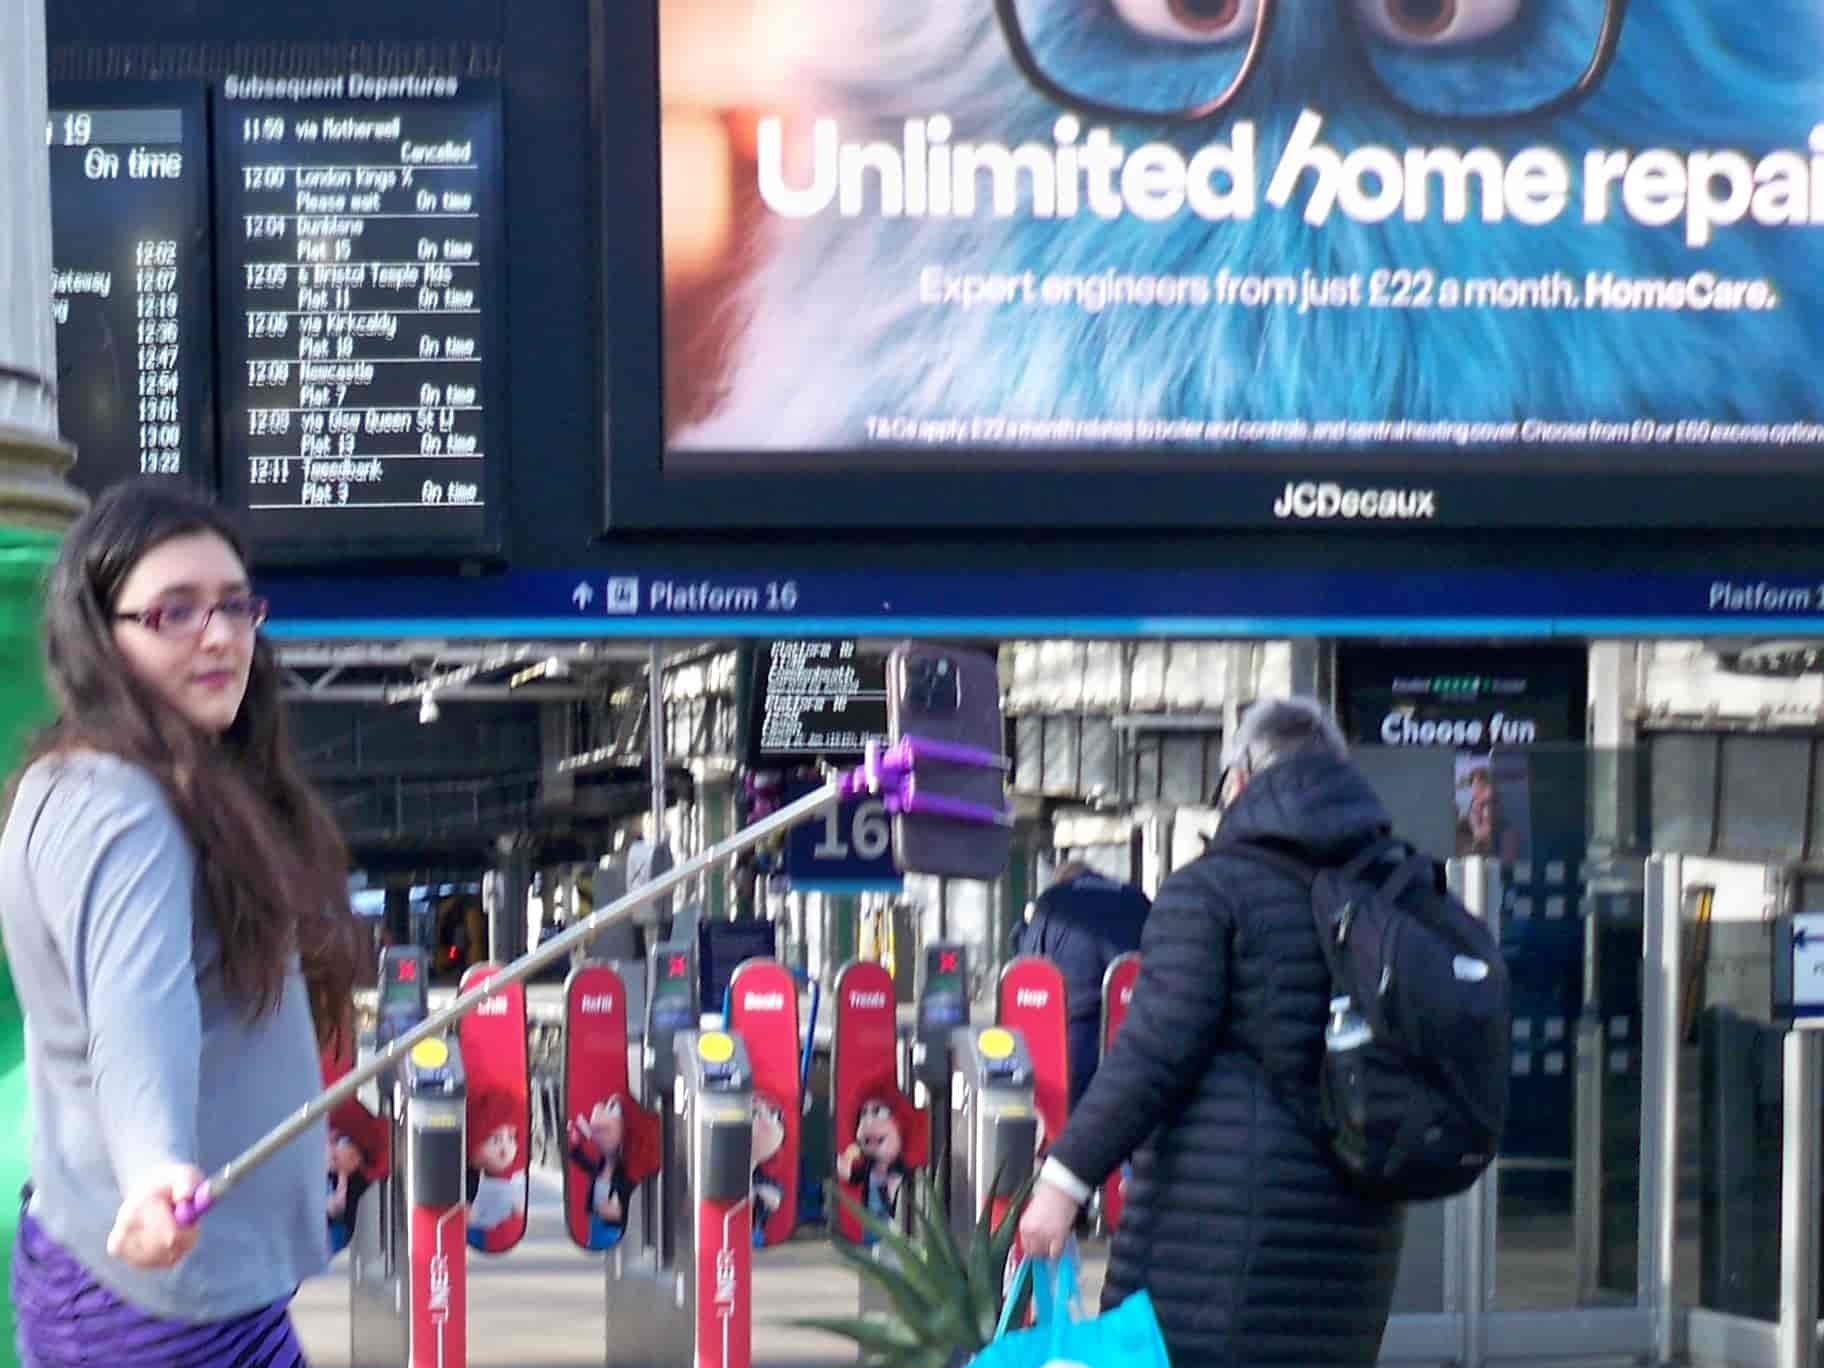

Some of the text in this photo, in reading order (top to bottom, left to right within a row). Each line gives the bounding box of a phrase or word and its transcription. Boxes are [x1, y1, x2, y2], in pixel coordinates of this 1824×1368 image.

[225, 73, 459, 102] Subsequent Departures
[63, 112, 91, 147] 19
[322, 116, 401, 141] Motherwell
[84, 146, 182, 179] On time
[401, 140, 472, 164] Cancelled
[296, 166, 397, 193] London Kings
[757, 113, 1256, 221] Unlimited
[1265, 108, 1570, 227] home
[297, 192, 346, 213] Please
[314, 262, 420, 292] Bristol Temple
[919, 265, 1779, 314] Expert engineers from just £22 a month. HomeCare.
[326, 311, 398, 341] Kirkcaldy
[299, 360, 375, 386] Newcastle
[364, 407, 413, 435] Queen
[301, 456, 384, 483] Tweedbank
[1273, 481, 1435, 518] JCDecaux
[650, 579, 798, 612] Platform 16
[1709, 580, 1809, 611] Platform
[1381, 711, 1536, 745] Choose fun
[812, 798, 891, 862] 16
